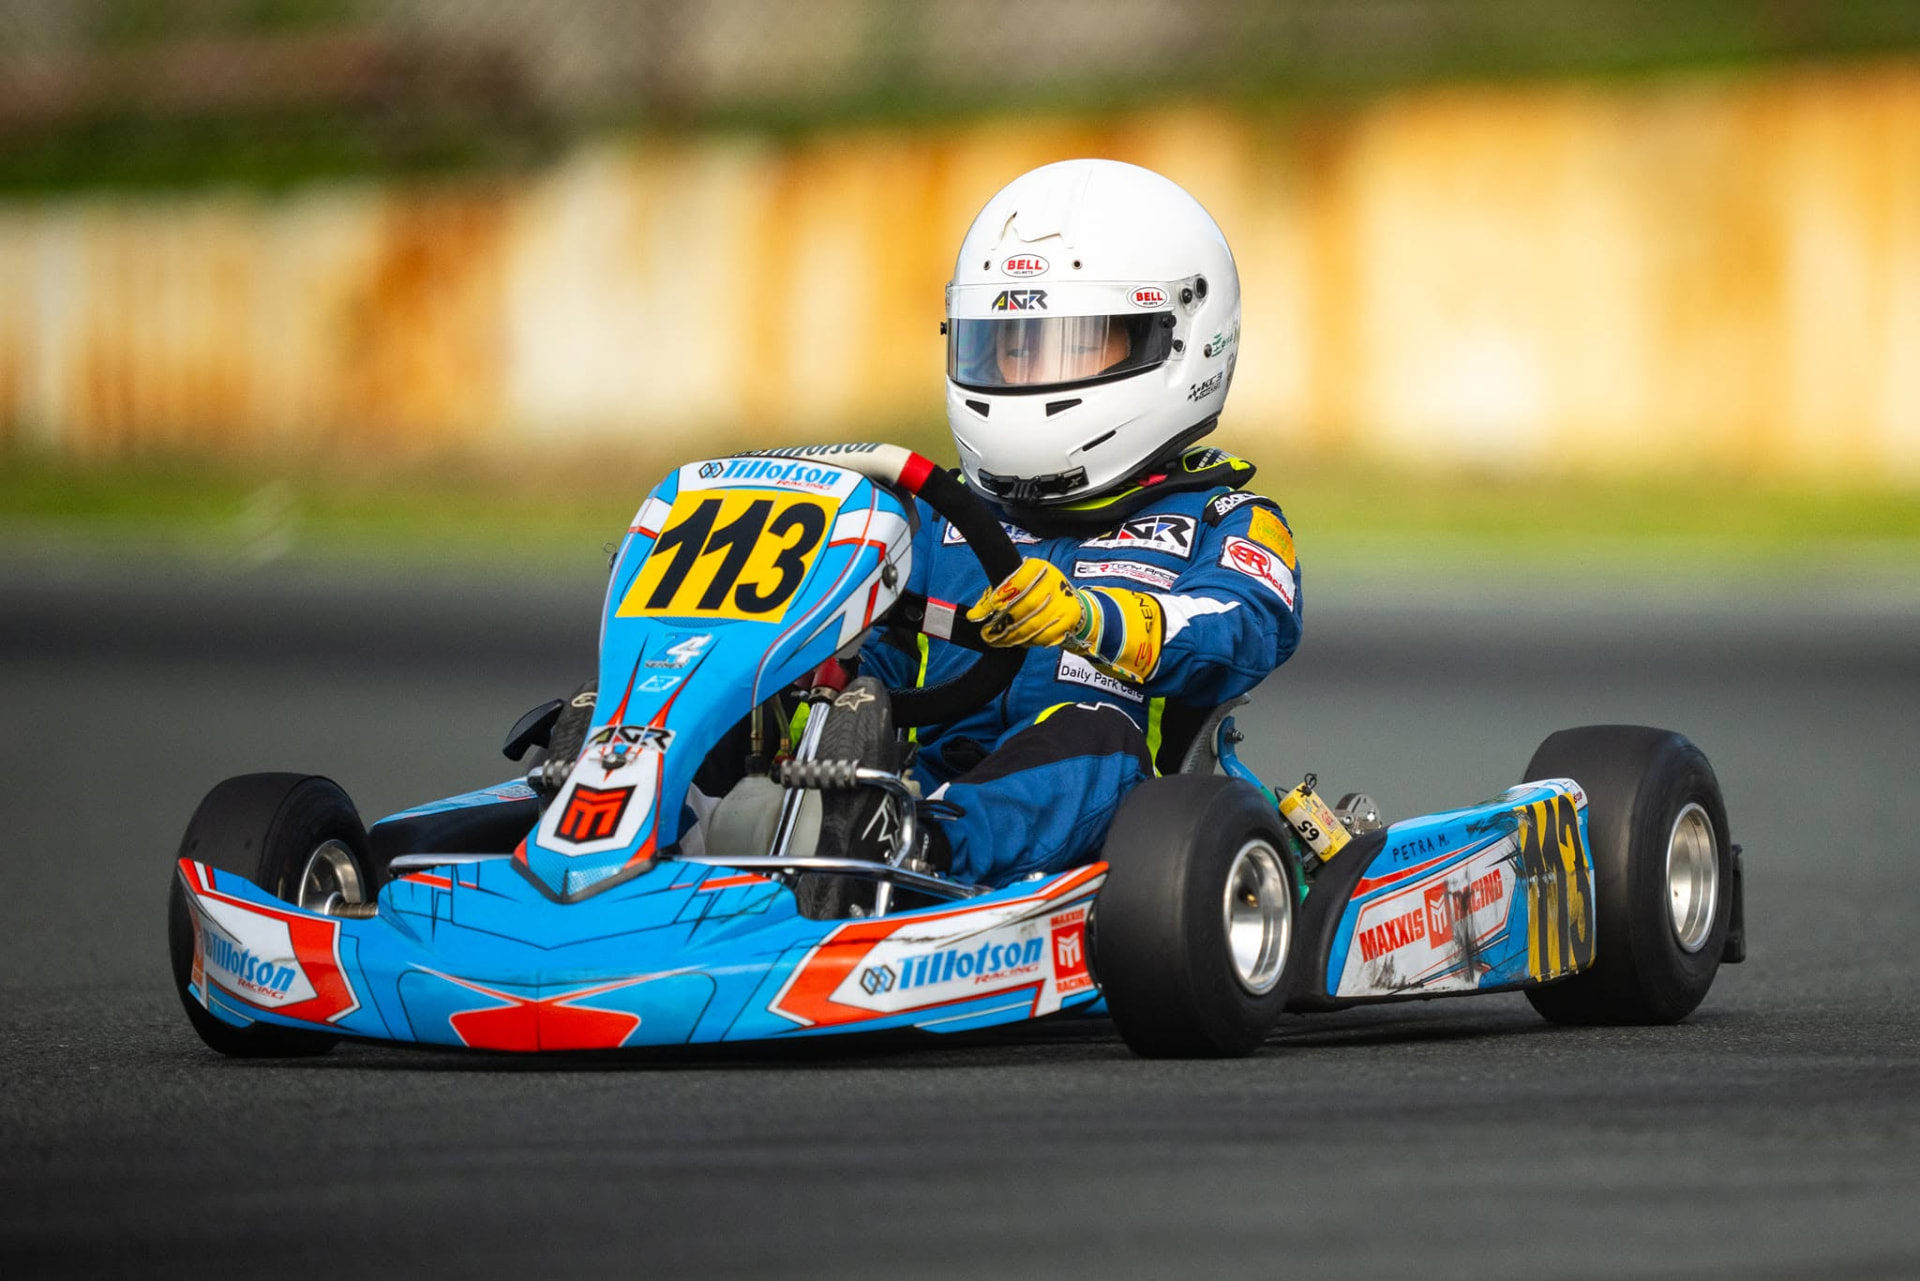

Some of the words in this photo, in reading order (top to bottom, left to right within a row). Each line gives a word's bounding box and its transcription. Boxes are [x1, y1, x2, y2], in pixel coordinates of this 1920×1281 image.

[1007, 259, 1043, 270] BELL
[991, 289, 1048, 311] AGR
[1136, 291, 1164, 302] BELL
[721, 459, 843, 486] Tillotson
[775, 479, 832, 491] RACING
[644, 498, 827, 615] 113
[1060, 665, 1092, 680] Daily
[1094, 671, 1119, 690] Park
[587, 725, 671, 751] AGR
[1392, 837, 1435, 863] PETRA
[1438, 833, 1451, 848] M.
[1522, 794, 1594, 979] 113
[1358, 907, 1426, 964] MAXXIS
[1452, 867, 1504, 923] RACING
[210, 931, 297, 993] Tillotson
[896, 936, 1044, 990] Tillotson
[974, 964, 1040, 985] RACING
[237, 977, 286, 1001] RACING
